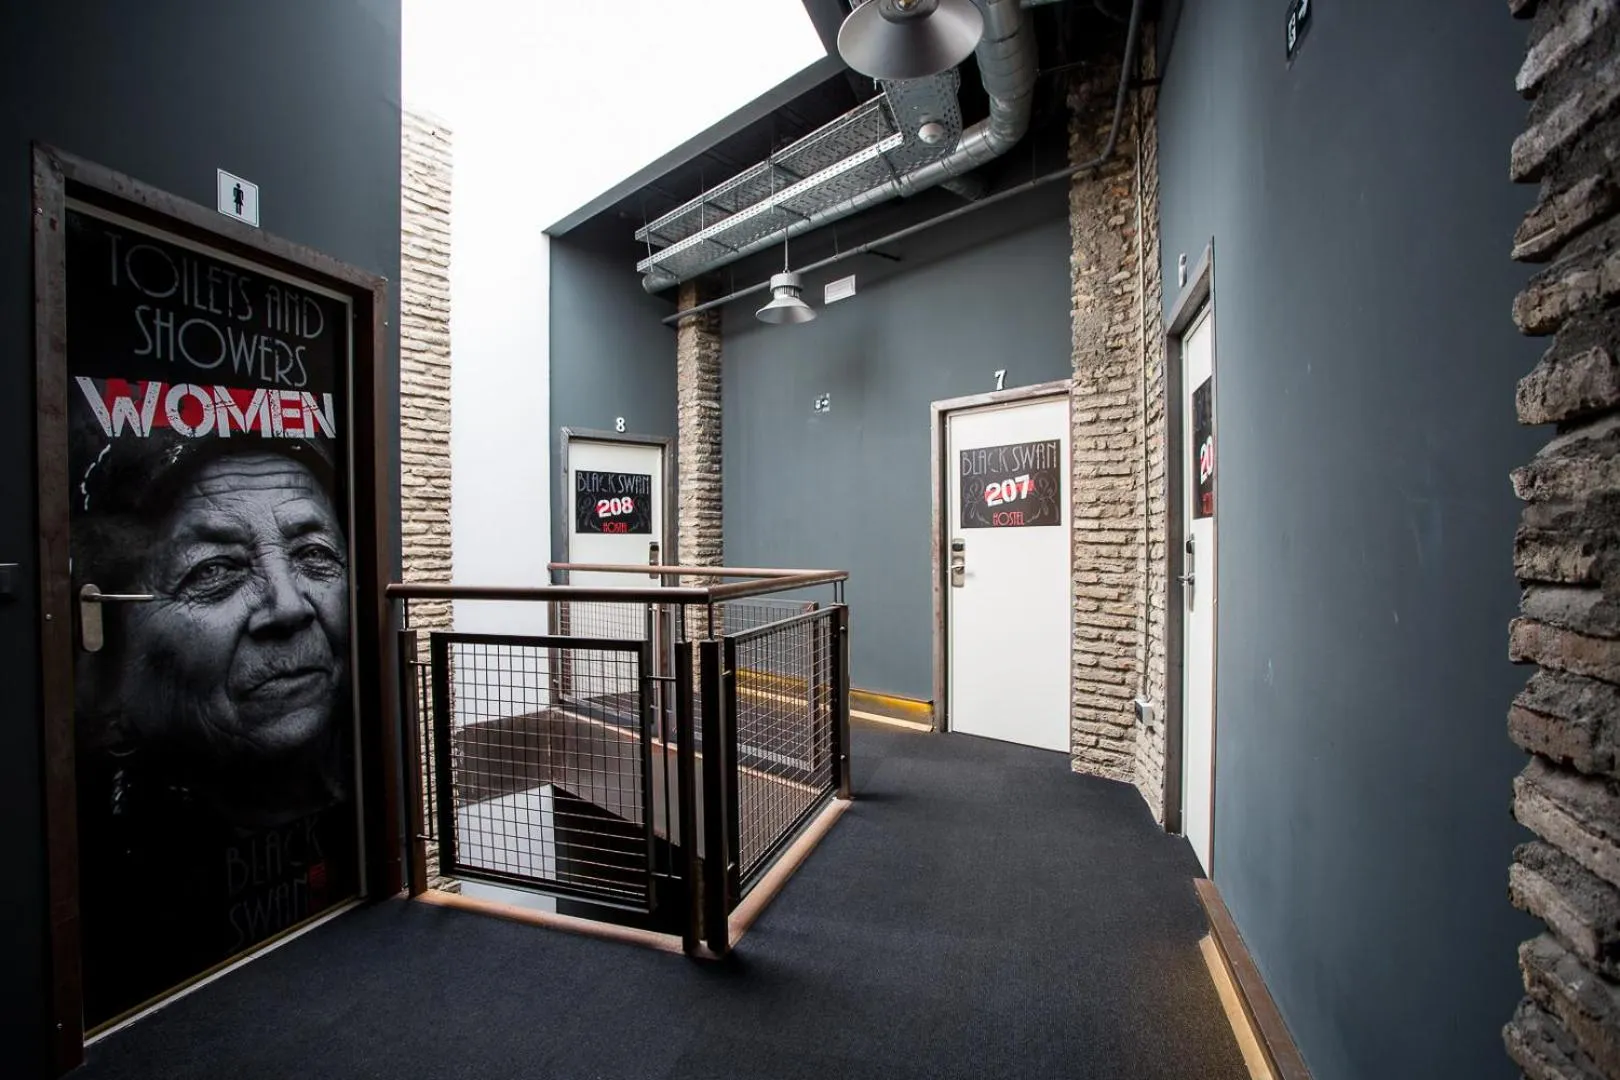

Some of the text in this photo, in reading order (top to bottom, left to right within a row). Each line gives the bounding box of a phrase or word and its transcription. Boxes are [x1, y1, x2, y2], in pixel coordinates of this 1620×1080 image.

[105, 232, 324, 338] TOILETS AND
[134, 304, 308, 387] SHOWERS
[994, 369, 1006, 391] 7
[75, 376, 336, 438] WOMEN
[615, 416, 626, 432] 8
[962, 441, 1057, 476] BLACK SWAN
[1200, 435, 1214, 485] 20
[577, 472, 650, 495] BLACK SWAN
[985, 474, 1031, 507] 207
[597, 496, 634, 518] 208
[992, 511, 1025, 526] HOSTEL
[225, 813, 324, 898] BLACK
